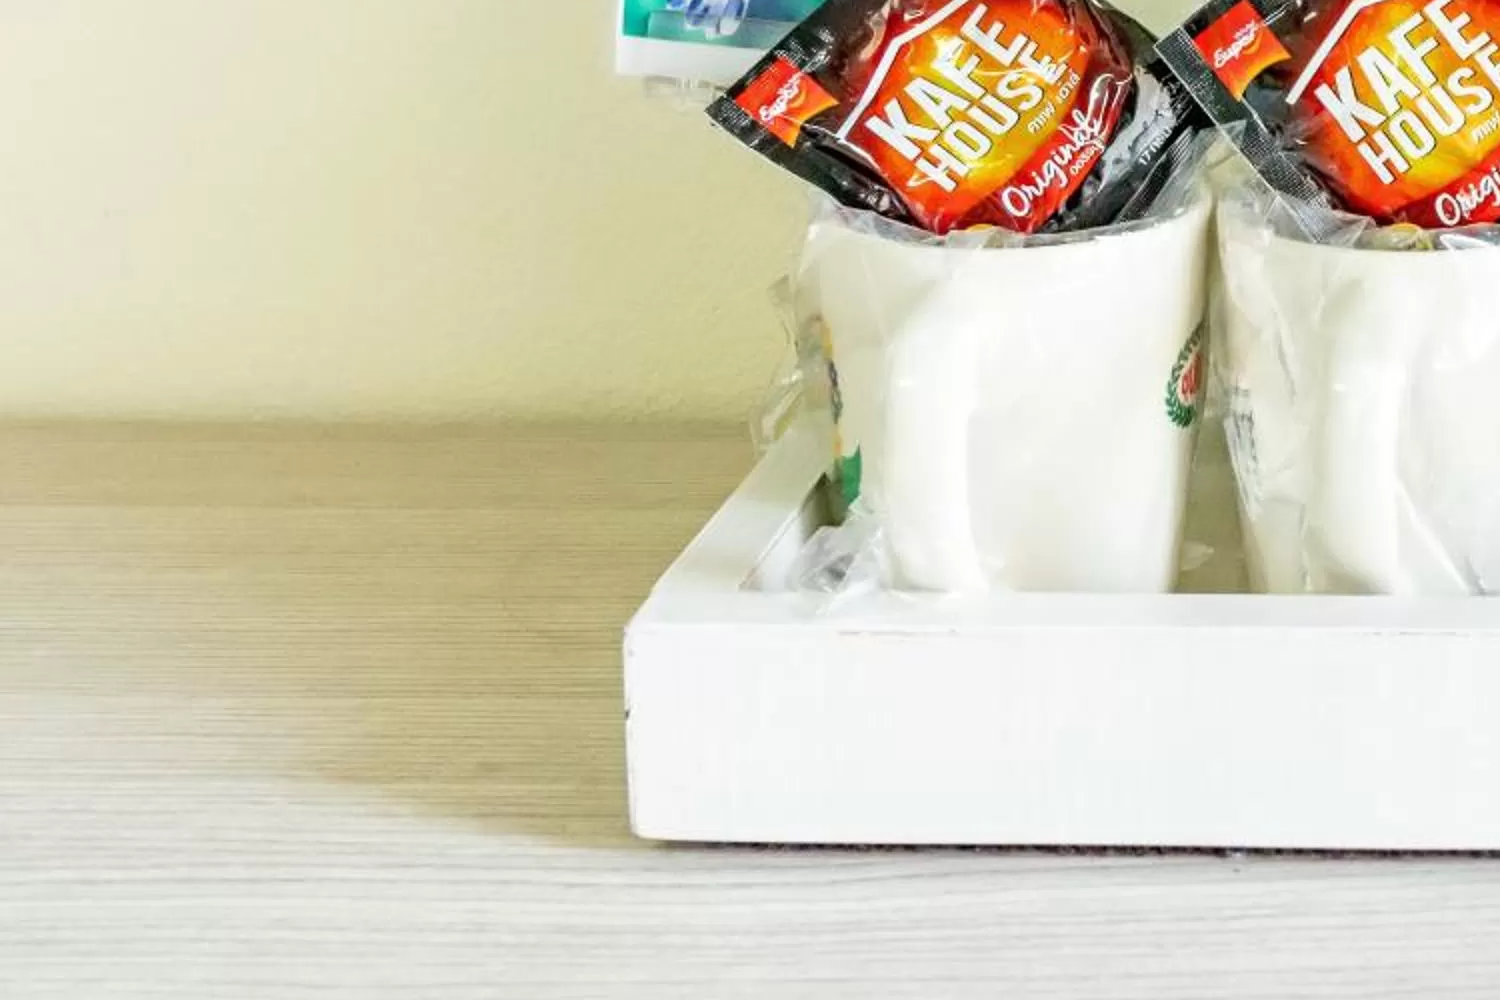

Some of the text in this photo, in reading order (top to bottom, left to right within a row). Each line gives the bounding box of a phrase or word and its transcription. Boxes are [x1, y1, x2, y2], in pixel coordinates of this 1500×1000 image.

[865, 3, 1028, 161] KAFE
[910, 41, 1068, 193] HOUSE
[1001, 107, 1103, 218] Original
